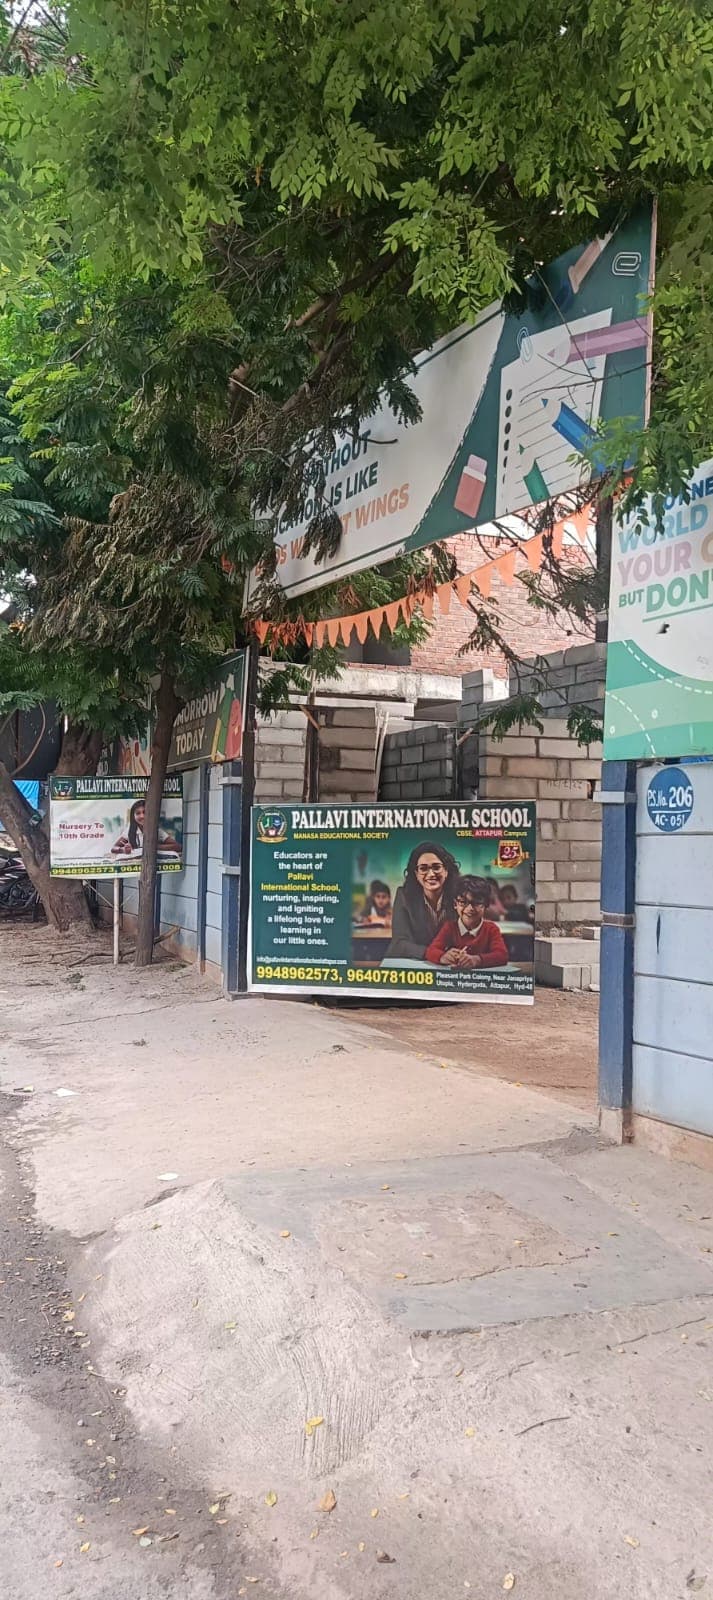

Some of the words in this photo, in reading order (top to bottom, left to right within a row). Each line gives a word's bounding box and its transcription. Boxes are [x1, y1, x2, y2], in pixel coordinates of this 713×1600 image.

[314, 429, 372, 478] THOUT
[345, 461, 379, 500] LIKE
[356, 483, 410, 530] WINGS
[617, 541, 692, 587] YOUR
[618, 589, 645, 608] BUT
[173, 689, 219, 728] MORROW
[176, 727, 205, 757] TODAY
[76, 779, 103, 793] PALLAVI
[104, 778, 150, 793] INTERNATION
[163, 778, 181, 792] HOOL
[668, 785, 693, 808] 206
[291, 809, 349, 830] PALLAVI
[351, 808, 469, 830] INTERNATIONAL
[471, 807, 532, 828] SCHOOL
[59, 822, 92, 830] Nursery
[293, 832, 319, 840] MANASA
[319, 832, 361, 840] EDUCATIONAL
[362, 831, 389, 840] SOCIETY
[475, 829, 502, 837] ATTAPUR
[503, 829, 528, 838] Campus
[273, 851, 313, 860] Educators
[314, 852, 328, 860] are
[500, 845, 519, 859] 25
[278, 861, 292, 870] the
[292, 861, 313, 870] heart
[314, 861, 324, 870] of
[287, 872, 314, 881] Pallavi
[261, 882, 309, 891] International
[311, 883, 341, 892] School,
[262, 894, 301, 903] nurturing,
[302, 894, 340, 904] inspiring,
[277, 904, 293, 912] and
[293, 905, 324, 914] igniting
[273, 915, 303, 925] lifelong
[304, 915, 322, 923] love
[322, 915, 335, 924] for
[280, 926, 312, 936] learning
[313, 926, 322, 934] in
[272, 937, 287, 945] our
[288, 937, 306, 945] little
[306, 938, 329, 946] ones.
[256, 965, 343, 983] 9948962573,
[346, 968, 434, 985] 9640781008
[436, 971, 459, 979] Pleasant
